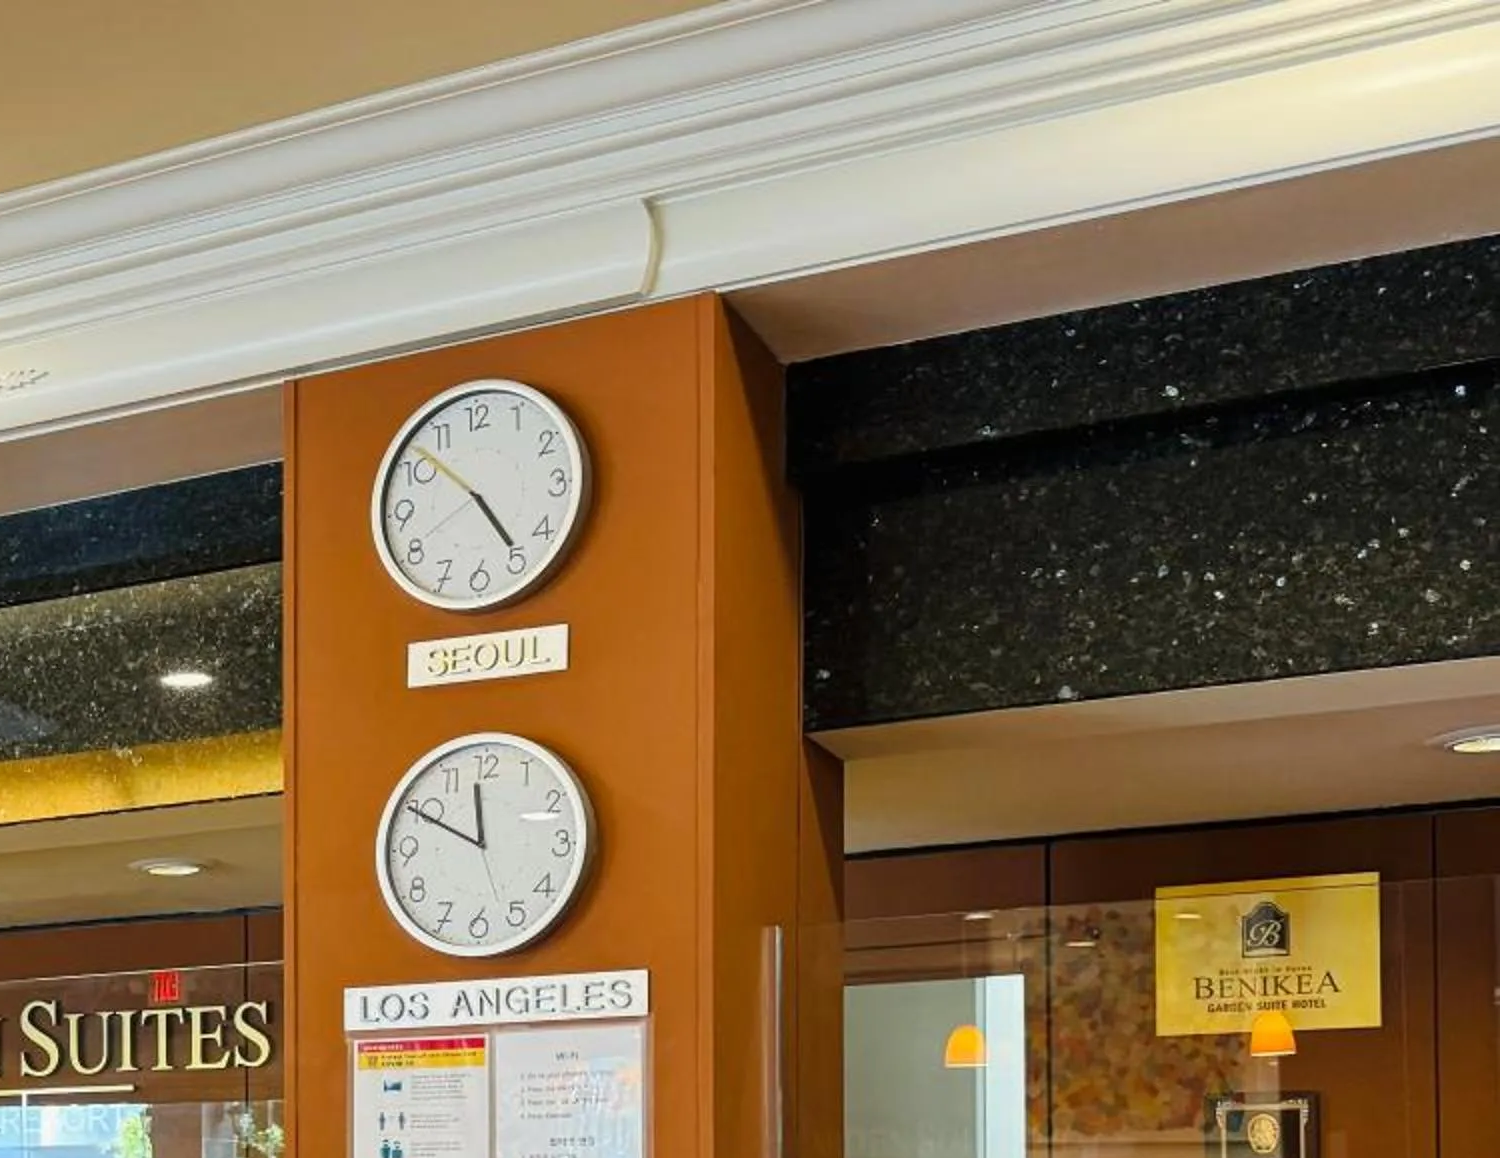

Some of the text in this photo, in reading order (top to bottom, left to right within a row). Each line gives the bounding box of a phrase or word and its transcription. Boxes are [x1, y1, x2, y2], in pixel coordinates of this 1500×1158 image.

[465, 404, 490, 432] 12
[510, 407, 521, 431] 1
[432, 424, 451, 450] 11
[539, 430, 555, 457] 2
[403, 458, 436, 486] 10
[548, 467, 566, 497] 3
[395, 499, 414, 532] 9
[532, 515, 554, 540] 4
[408, 539, 424, 564] 8
[507, 546, 526, 574] 5
[437, 560, 452, 592] 7
[470, 559, 490, 592] 6
[427, 636, 550, 676] SEOUL
[443, 768, 459, 794] 11
[474, 754, 499, 780] 12
[520, 761, 529, 786] 1
[408, 798, 445, 823] 10
[545, 790, 561, 813] 2
[400, 836, 419, 867] 9
[552, 829, 571, 857] 3
[410, 877, 426, 902] 8
[533, 872, 555, 898] 4
[437, 902, 453, 933] 7
[469, 907, 489, 938] 6
[506, 901, 526, 926] 5
[1193, 970, 1342, 1000] BENIKEA
[359, 980, 633, 1022] LOS ANGELES
[1291, 999, 1328, 1009] HOTEL
[19, 1000, 271, 1077] SUITES
[1, 1103, 126, 1136] REORT
